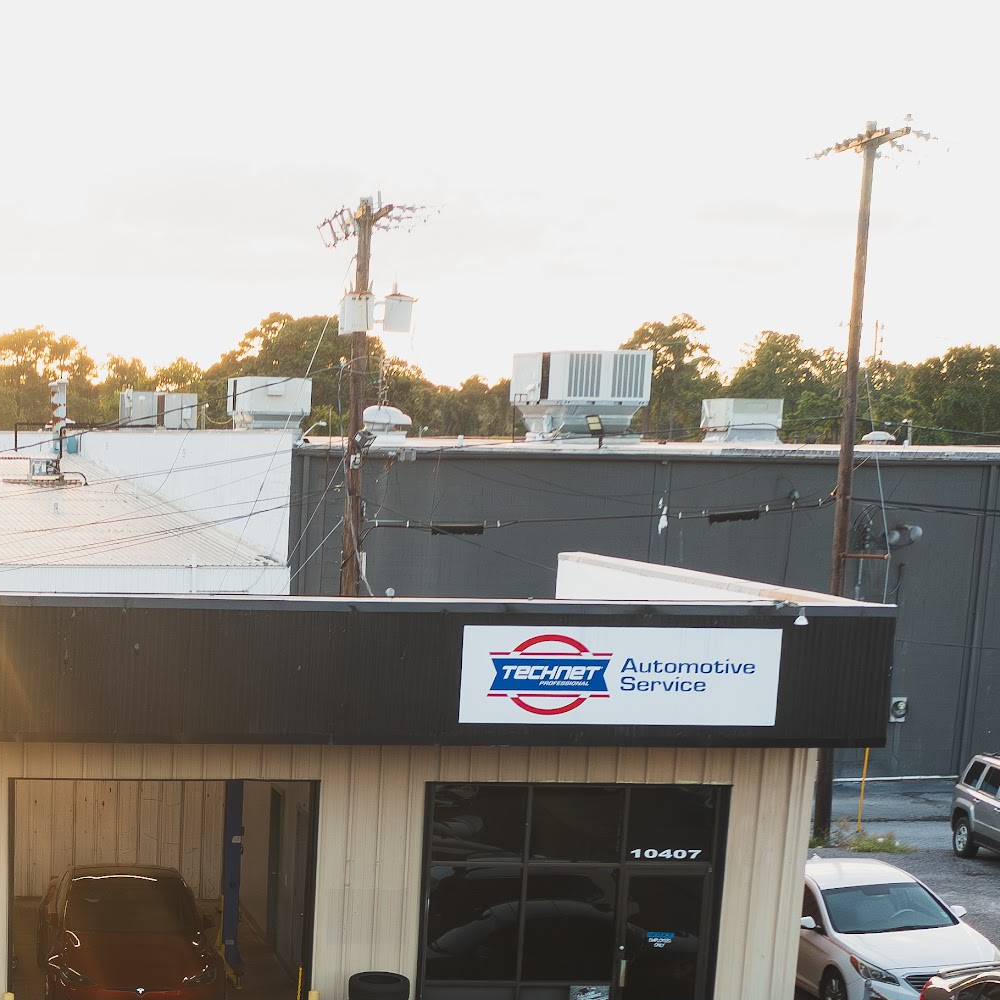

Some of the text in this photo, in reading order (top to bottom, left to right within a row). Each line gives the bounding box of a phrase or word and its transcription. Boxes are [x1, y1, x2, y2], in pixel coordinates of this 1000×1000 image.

[620, 657, 756, 675] Automotive
[620, 676, 707, 692] Service
[630, 848, 703, 860] 10407
